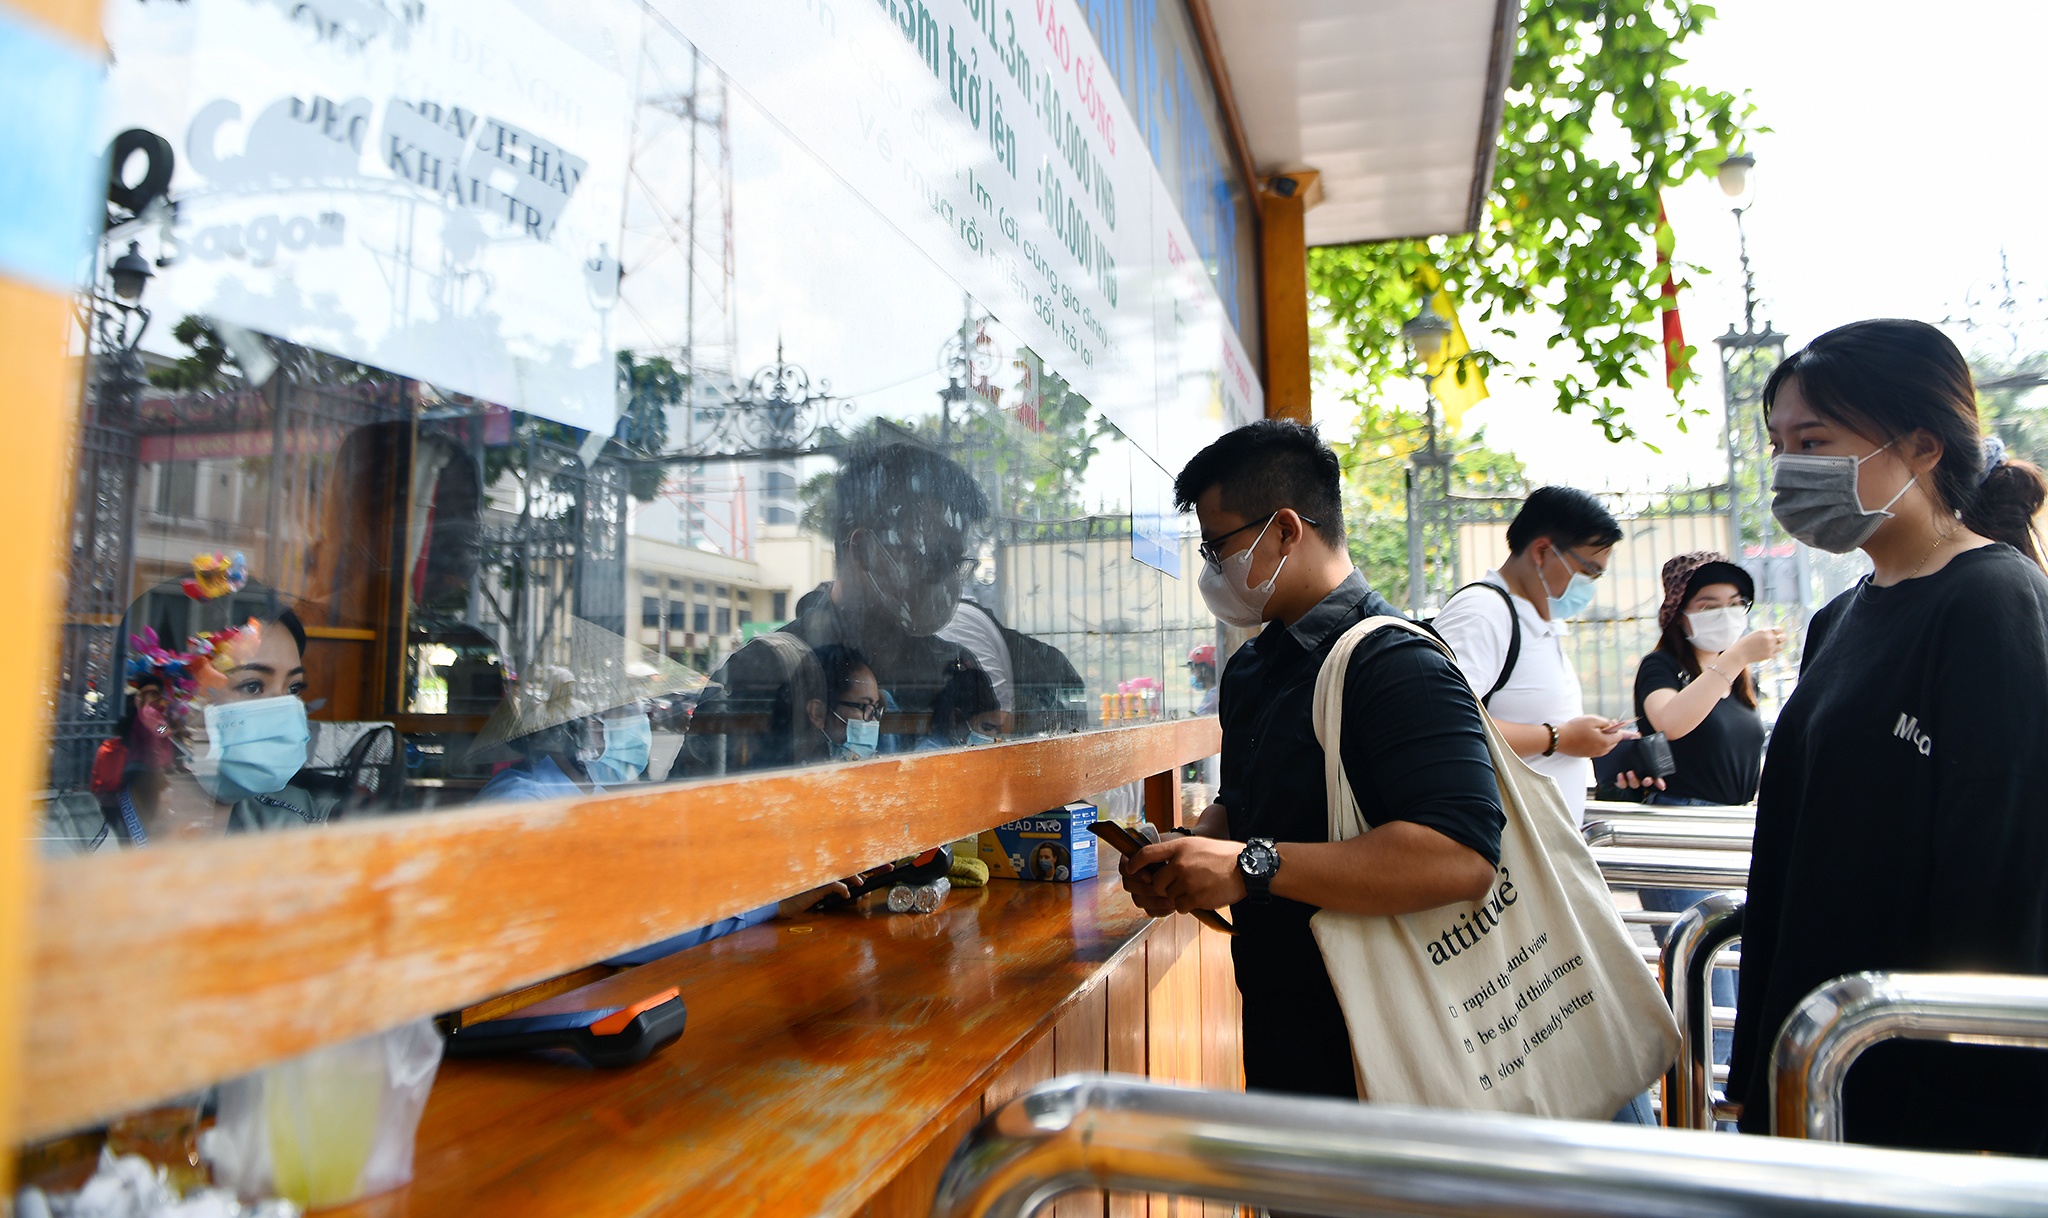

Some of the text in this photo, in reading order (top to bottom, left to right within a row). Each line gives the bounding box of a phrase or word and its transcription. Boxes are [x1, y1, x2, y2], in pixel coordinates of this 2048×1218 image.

[947, 24, 982, 131] trở
[988, 79, 1016, 181] lên
[902, 157, 954, 229] mua
[960, 216, 984, 259] rồi
[1061, 319, 1078, 355] trả
[1080, 339, 1094, 371] lại
[968, 166, 993, 219] 1m
[1023, 239, 1058, 296] cùng
[1061, 283, 1080, 317] gia
[1001, 820, 1032, 832] LEAD
[1463, 980, 1498, 1013] rapid
[1527, 932, 1549, 956] view
[1477, 1021, 1498, 1045] be
[1526, 973, 1554, 1002] think
[1552, 955, 1585, 981] more
[1497, 1055, 1526, 1082] slow
[1530, 1014, 1564, 1048] steady
[1559, 989, 1595, 1020] better
